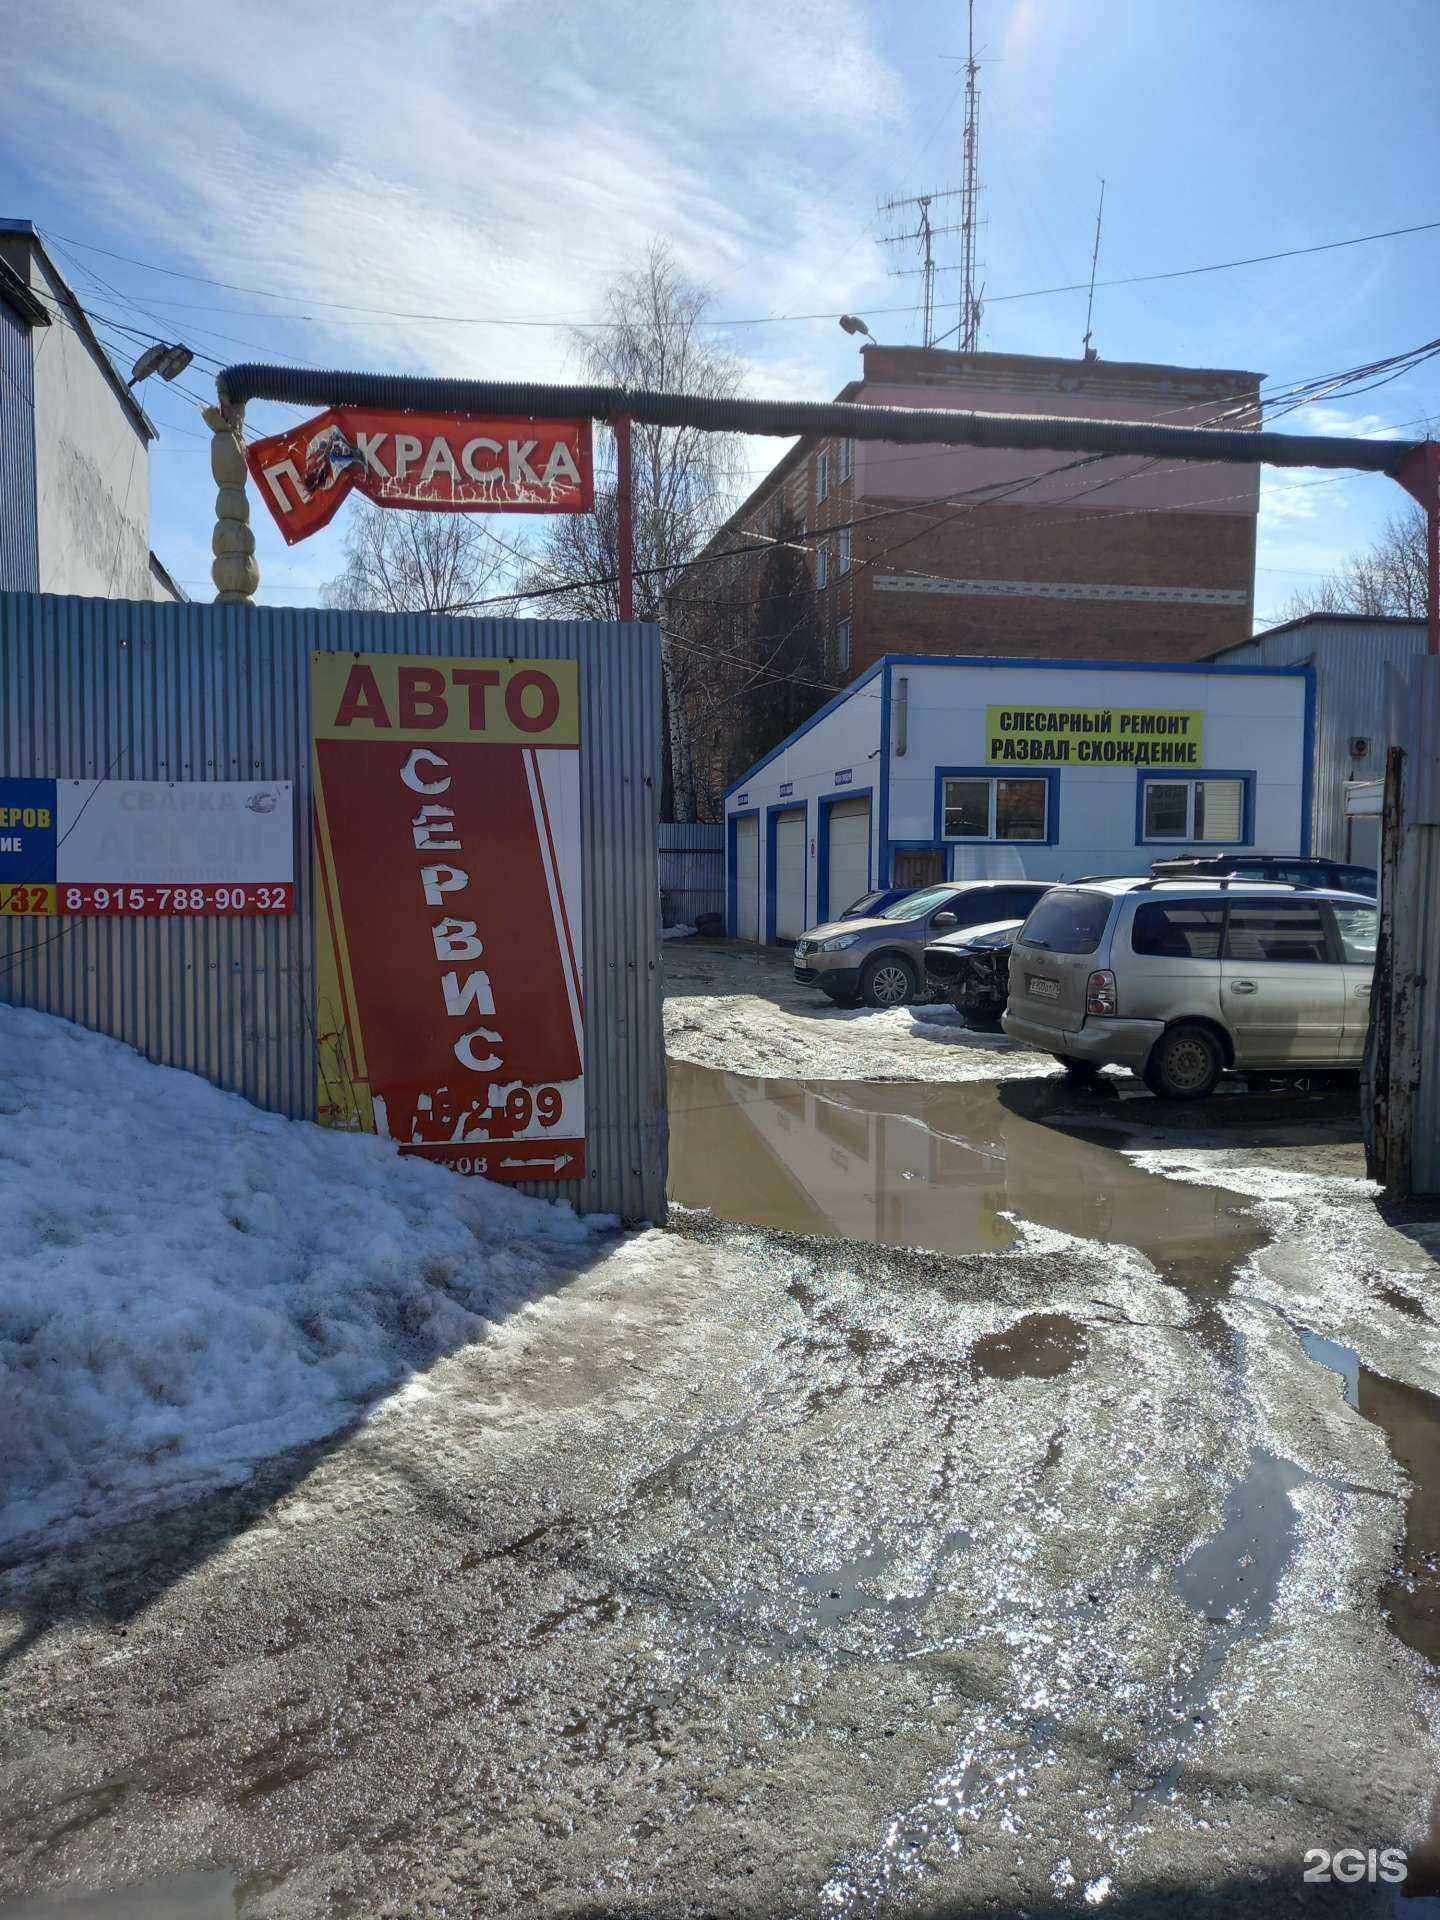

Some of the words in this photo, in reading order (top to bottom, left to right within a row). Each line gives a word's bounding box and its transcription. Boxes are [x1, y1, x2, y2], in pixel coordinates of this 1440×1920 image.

[334, 664, 560, 733] АВТО
[1000, 711, 1112, 733] СЛЕСАРНЫЙ
[1120, 714, 1190, 735] РЕМОНТ
[991, 738, 1197, 765] РАЗВАЛ-СХОЖДЕНИЕ
[66, 887, 286, 910] 8-915-788-90-32
[400, 748, 504, 1072] СЕРВИС
